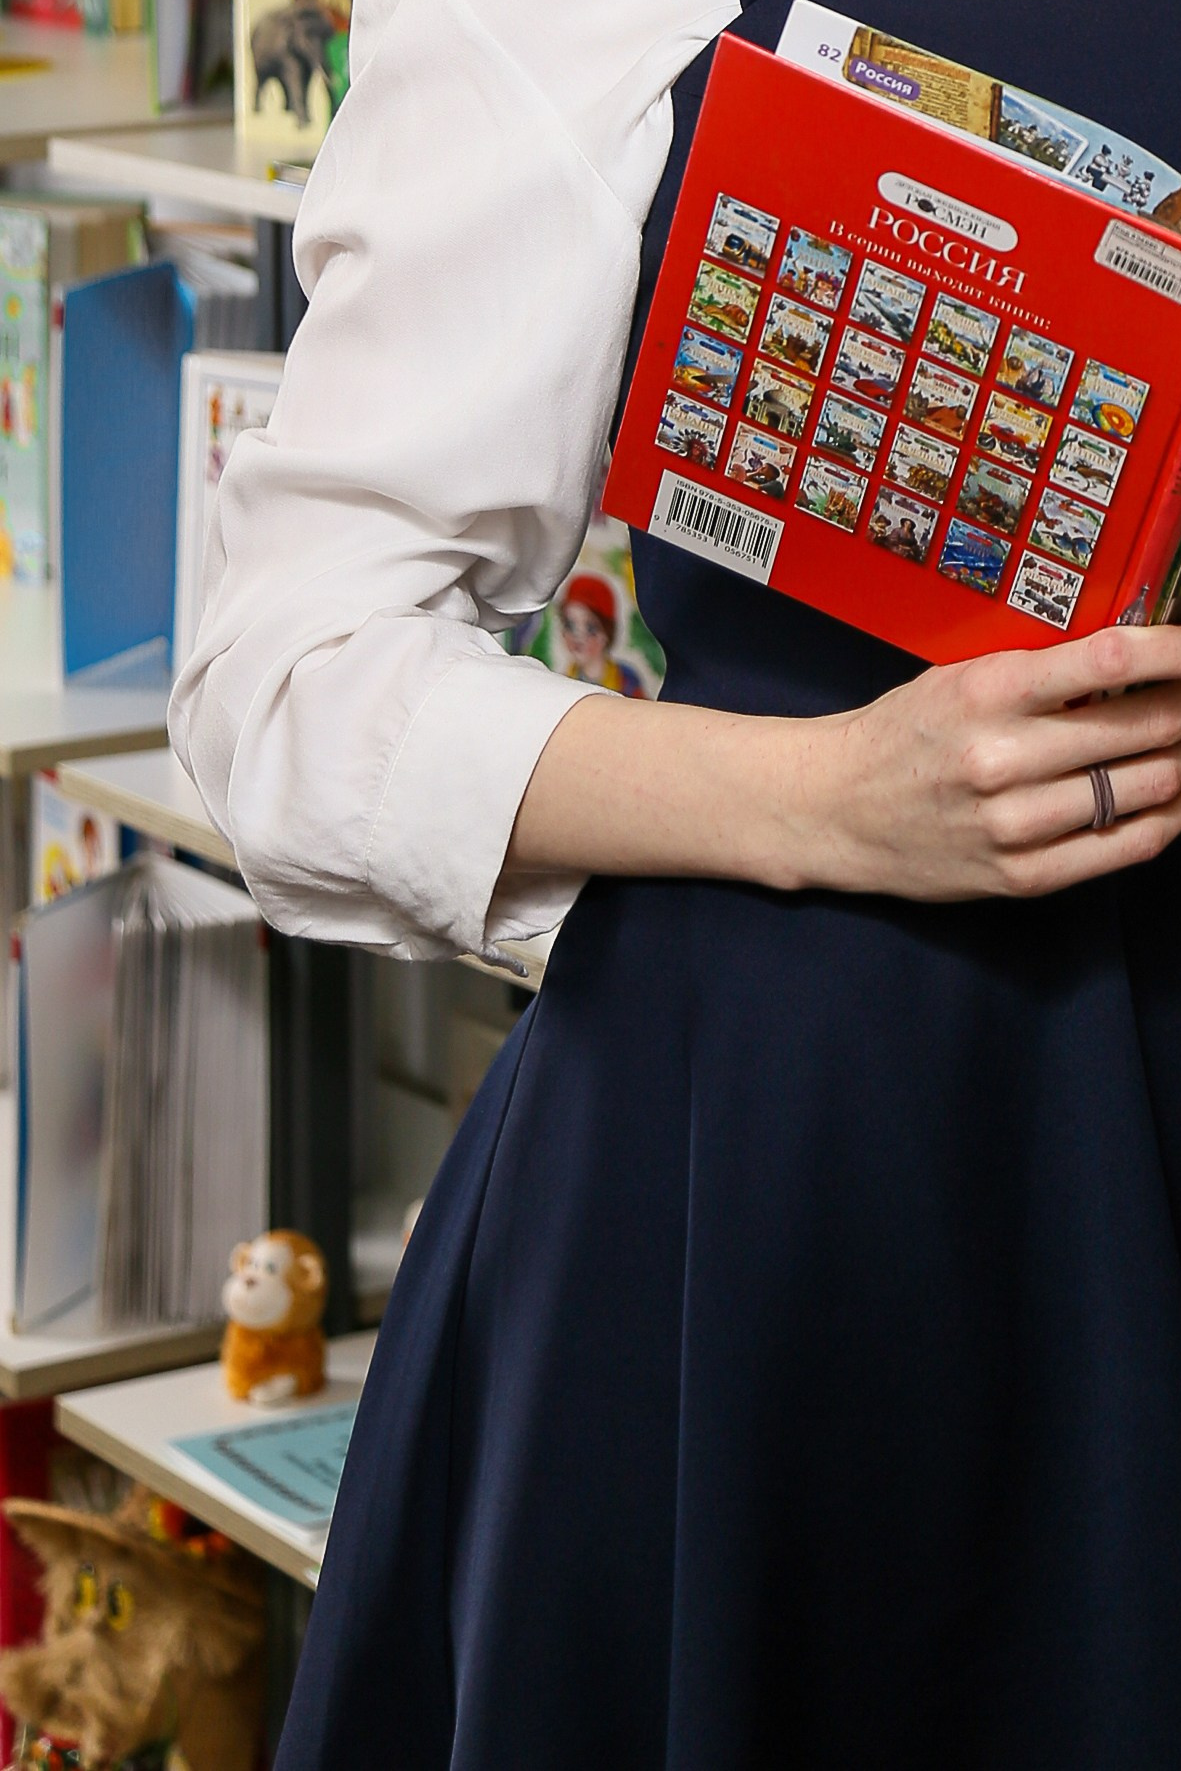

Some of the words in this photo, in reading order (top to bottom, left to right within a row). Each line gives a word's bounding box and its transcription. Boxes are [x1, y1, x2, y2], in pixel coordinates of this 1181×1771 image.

[817, 43, 843, 63] 82
[854, 61, 914, 96] Россия
[829, 220, 845, 237] В
[847, 233, 902, 264] серии
[906, 258, 987, 301] выходят
[866, 204, 1029, 296] РОССИЯ
[676, 479, 698, 494] ISBN
[699, 489, 779, 529] 978-5-353-05675-1
[675, 523, 708, 544] 785353
[724, 545, 757, 565] 056751
